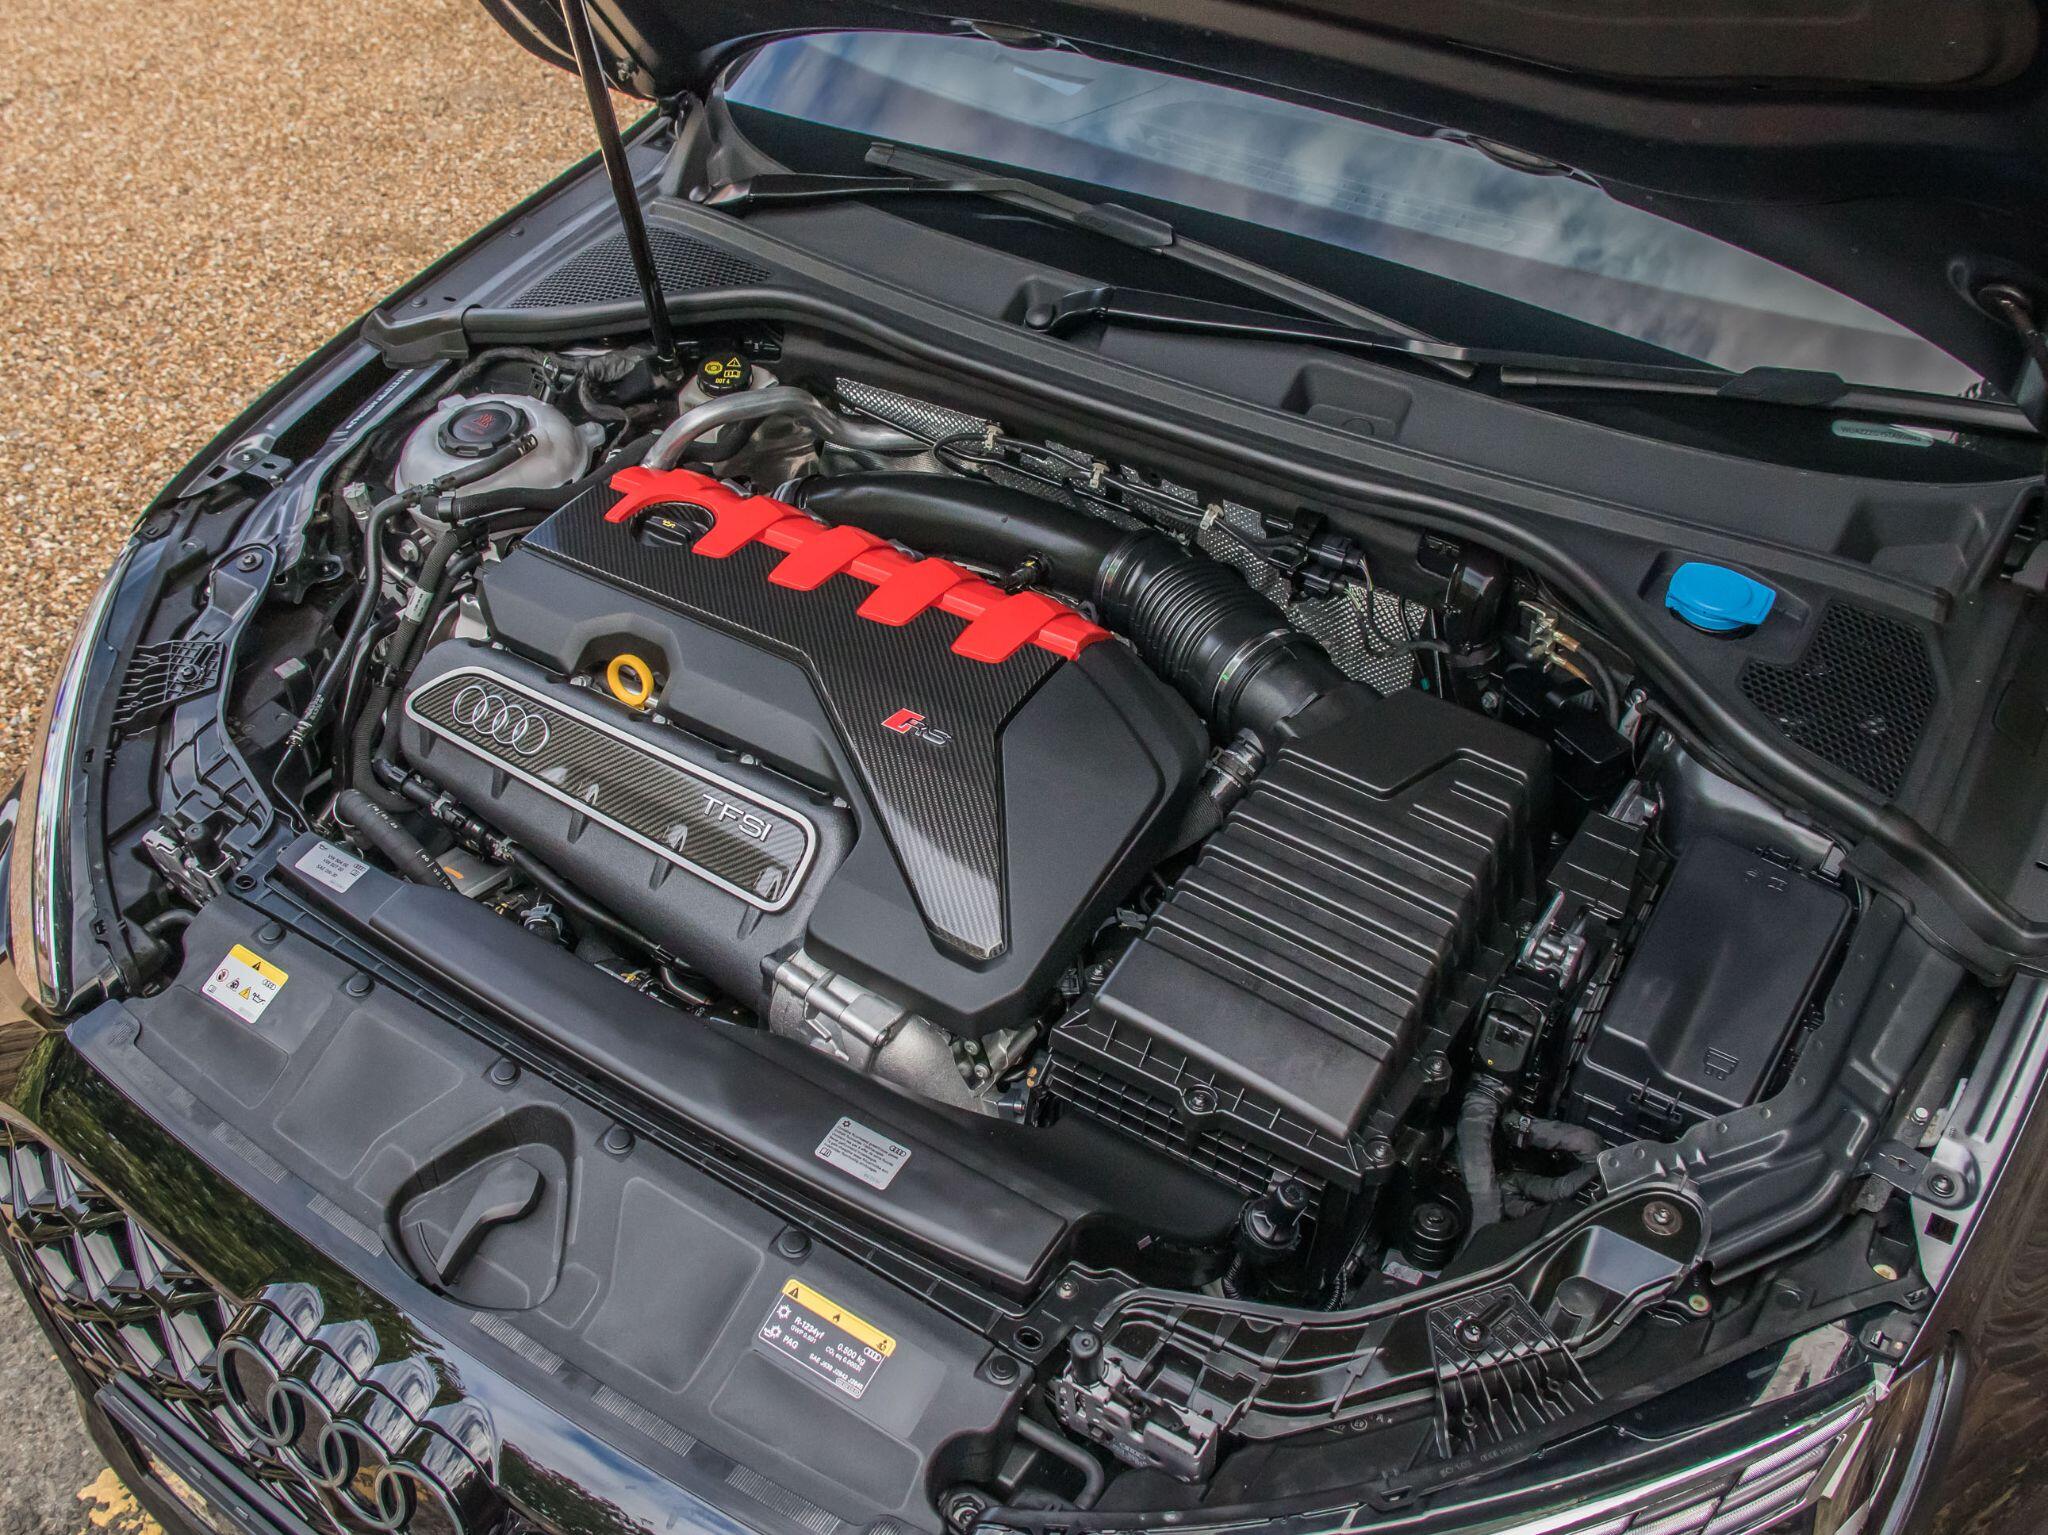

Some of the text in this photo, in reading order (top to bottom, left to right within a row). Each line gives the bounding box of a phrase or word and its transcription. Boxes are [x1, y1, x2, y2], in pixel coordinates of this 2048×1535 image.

[892, 712, 952, 746] RS
[702, 793, 773, 842] TFSI
[794, 1316, 825, 1339] R-1234yf
[782, 1335, 799, 1350] PAG
[837, 1343, 866, 1367] 0.500 kg
